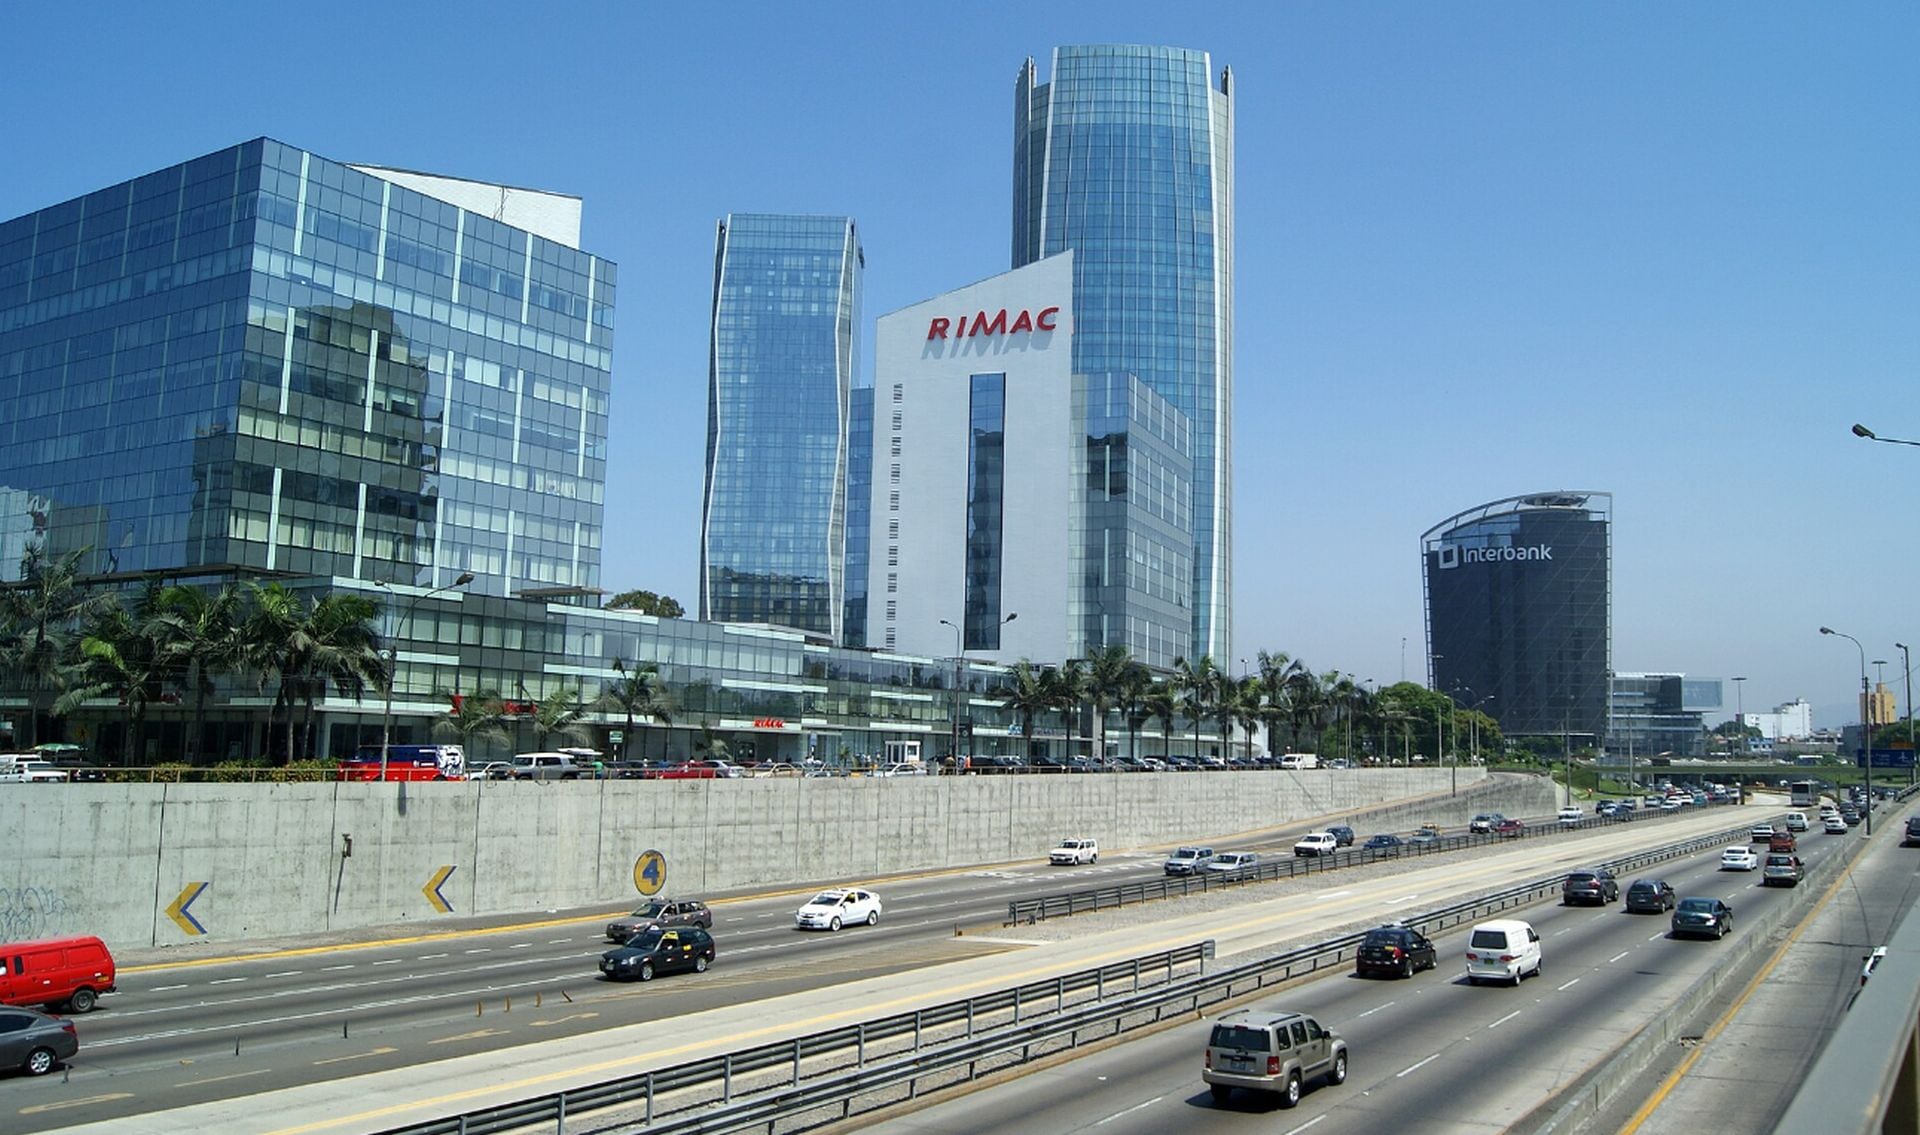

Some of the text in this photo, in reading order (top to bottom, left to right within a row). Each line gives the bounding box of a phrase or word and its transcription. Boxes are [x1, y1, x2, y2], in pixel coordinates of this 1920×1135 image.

[927, 306, 1059, 341] RIMAC
[1462, 544, 1553, 563] Interbank
[642, 858, 660, 886] 4
